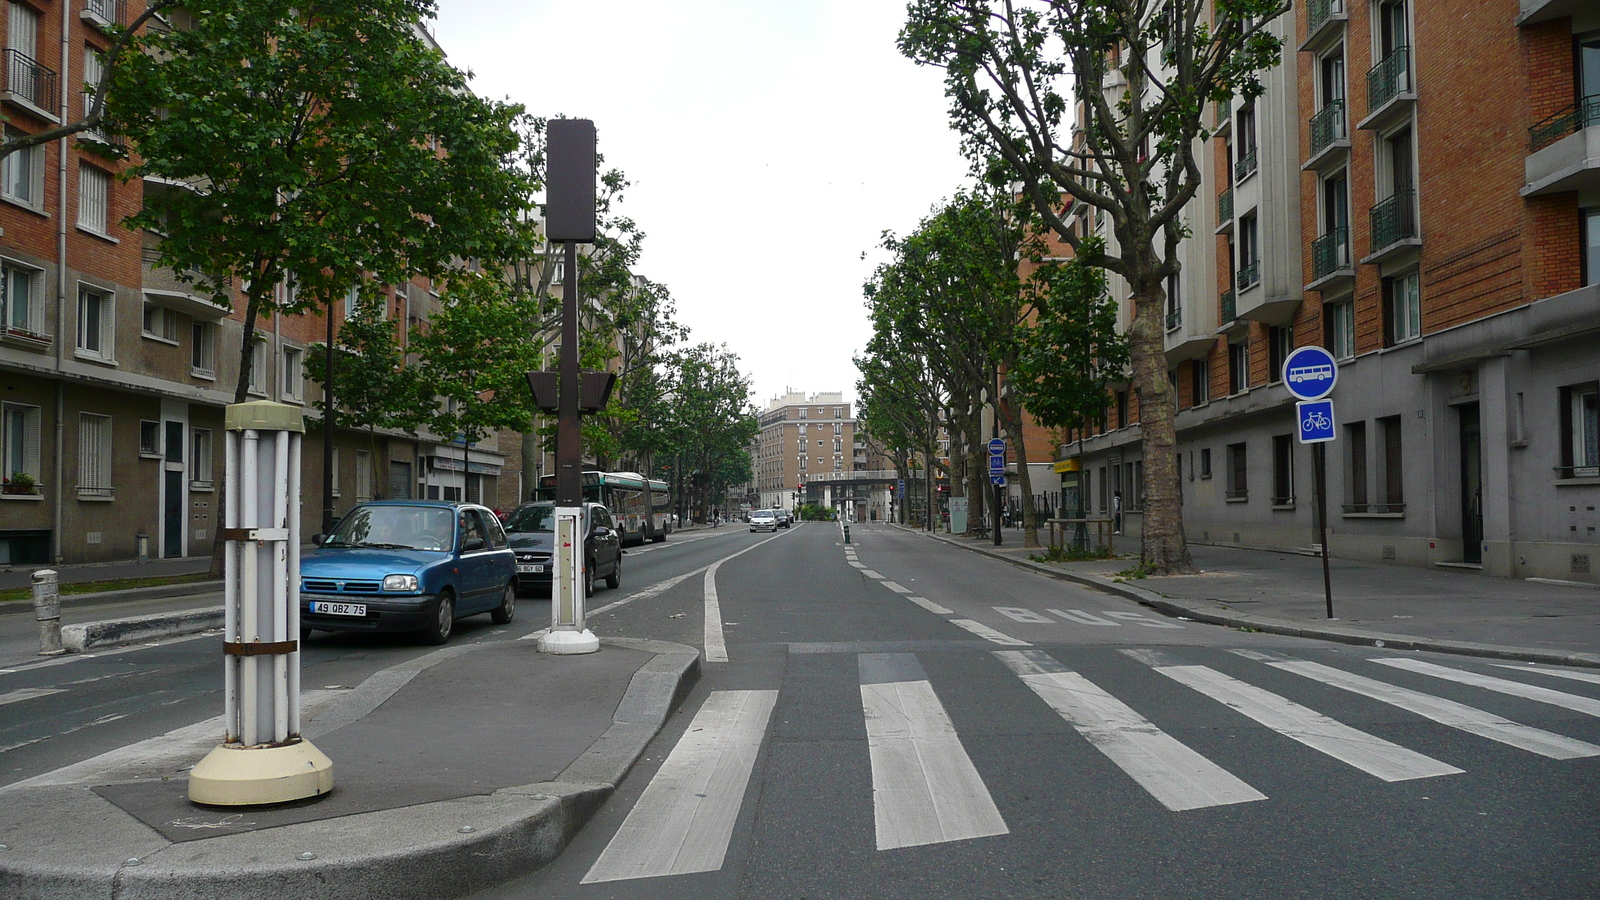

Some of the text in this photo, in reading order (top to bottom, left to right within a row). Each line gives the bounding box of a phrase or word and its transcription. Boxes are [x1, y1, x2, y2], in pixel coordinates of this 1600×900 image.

[317, 603, 364, 614] 49 QBZ 75
[991, 606, 1186, 629] BUS
